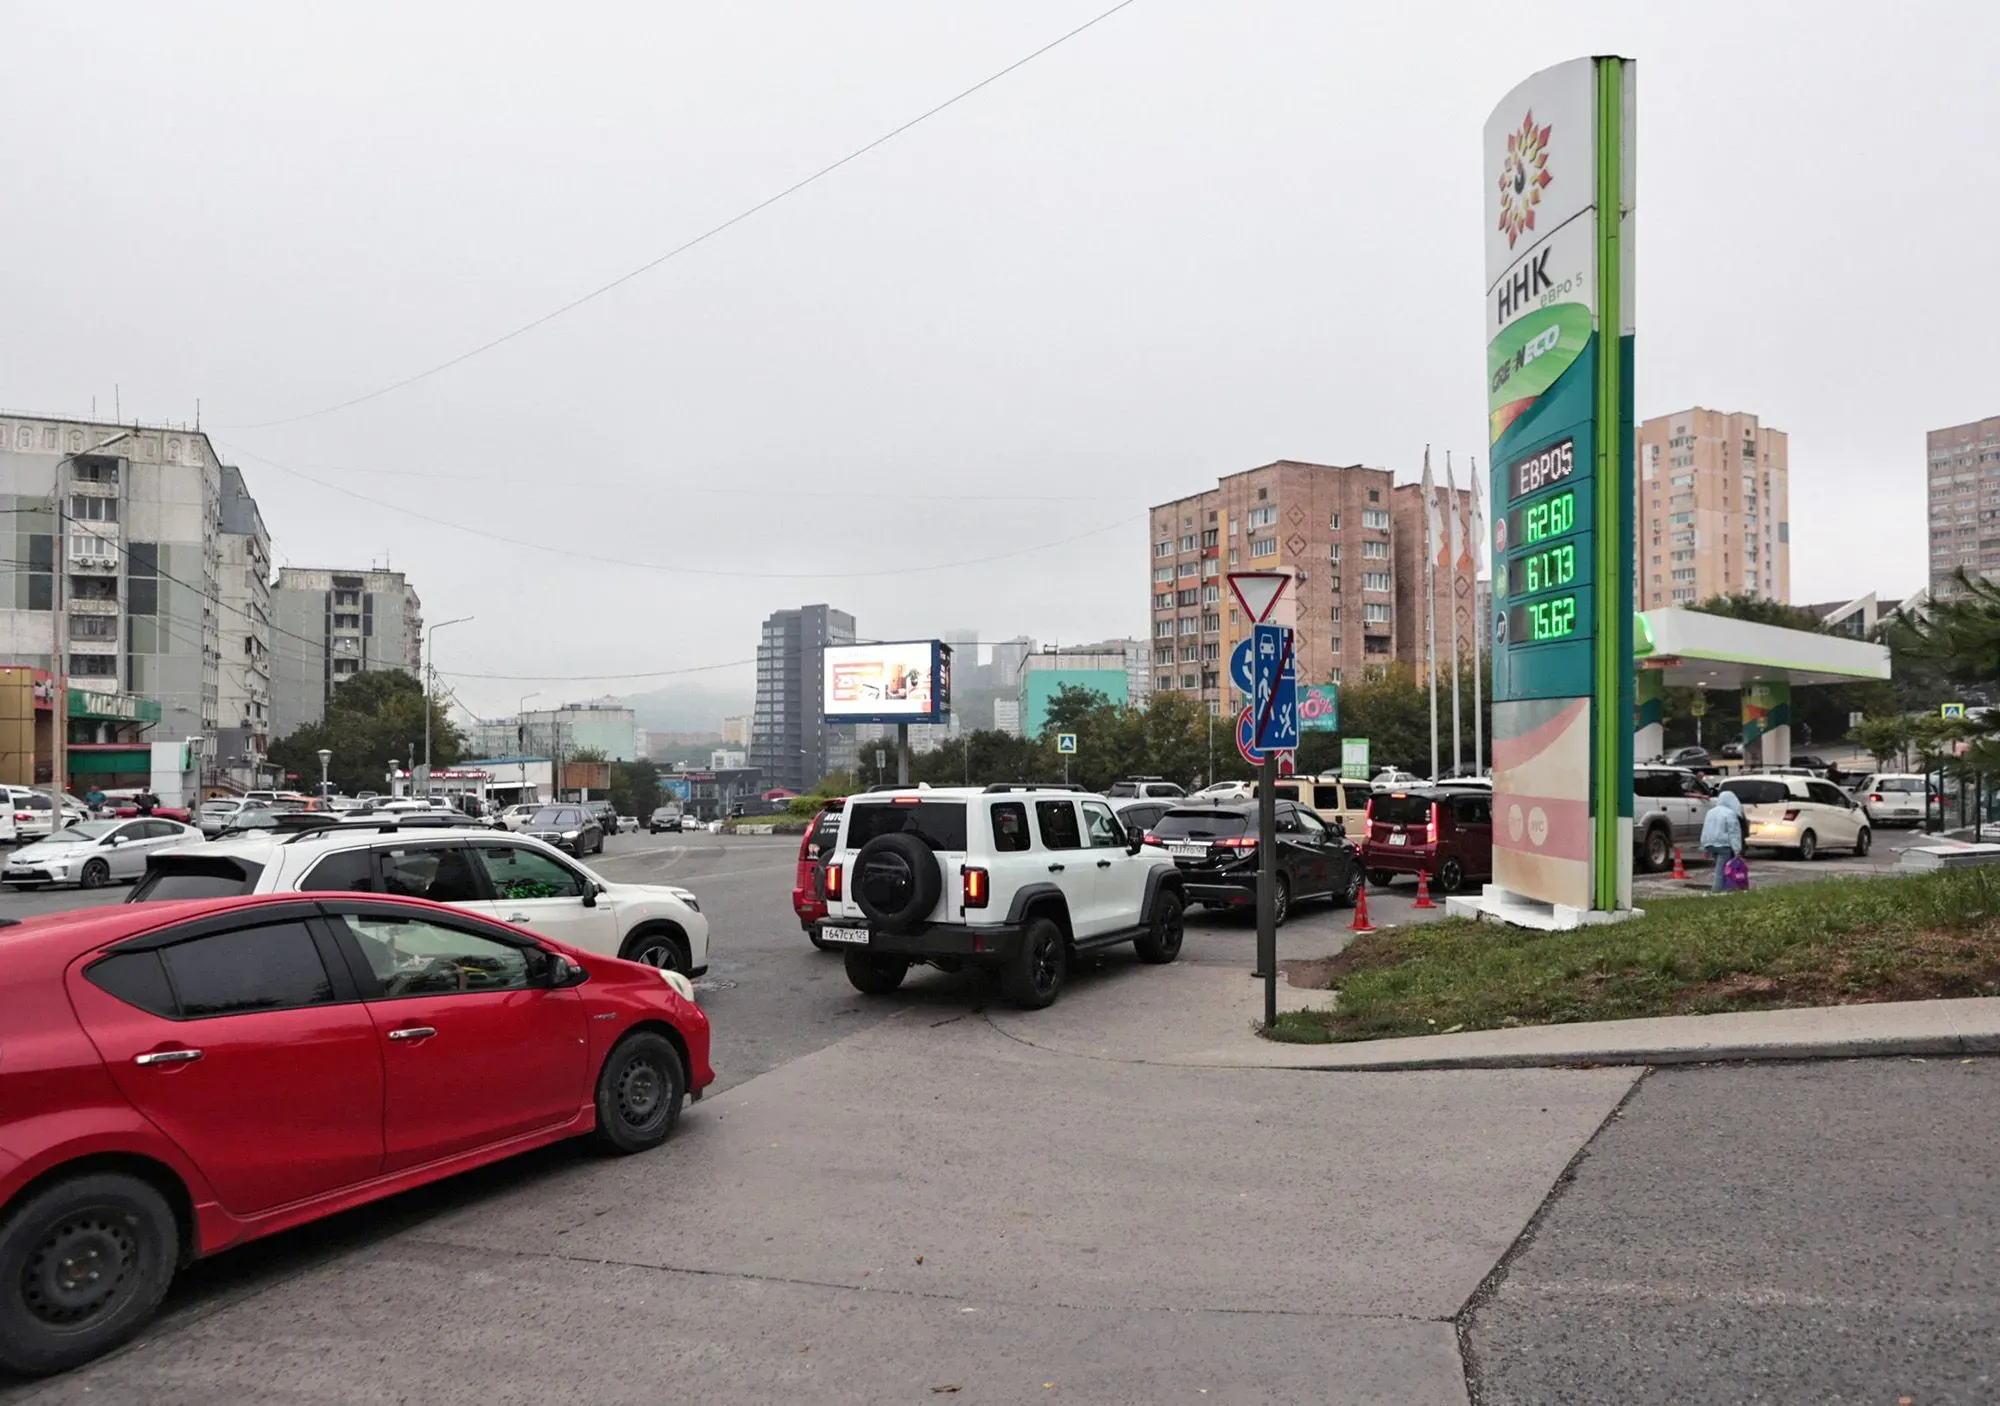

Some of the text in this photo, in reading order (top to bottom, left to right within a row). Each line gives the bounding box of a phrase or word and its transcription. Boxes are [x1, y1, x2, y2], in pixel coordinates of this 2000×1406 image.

[1498, 246, 1553, 325] ННК
[1575, 271, 1583, 287] 5
[1491, 323, 1560, 393] GRENECO
[1527, 544, 1574, 592] 61.73
[1298, 698, 1334, 720] 10%
